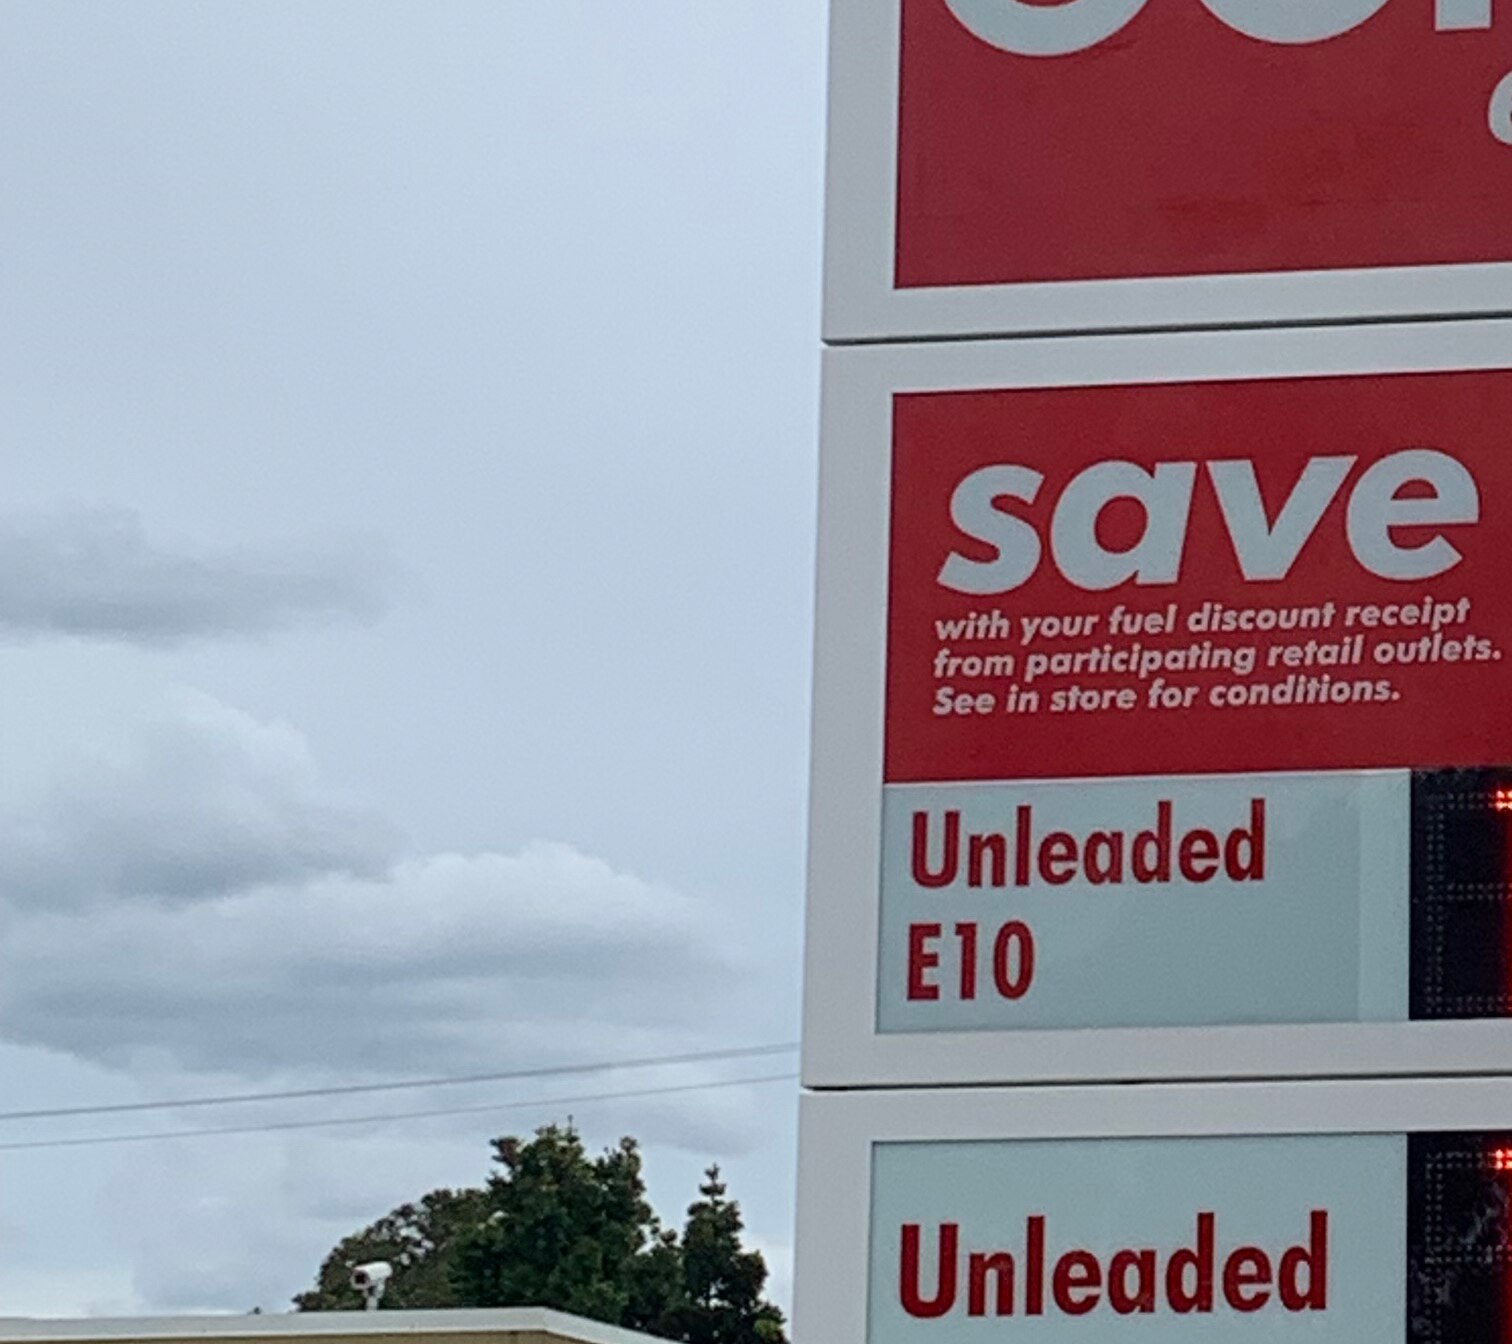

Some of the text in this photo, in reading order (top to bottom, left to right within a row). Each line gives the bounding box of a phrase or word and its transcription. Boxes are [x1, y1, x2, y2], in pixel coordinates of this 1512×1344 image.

[936, 449, 1479, 595] save
[932, 632, 1501, 682] from participating retail outlets.
[934, 595, 1471, 646] with your fuel discount receipt
[932, 672, 1400, 716] See in store for conditions.
[912, 798, 1266, 888] Unleaded
[908, 921, 1034, 1001] E10
[899, 1210, 1328, 1319] Unleaded
